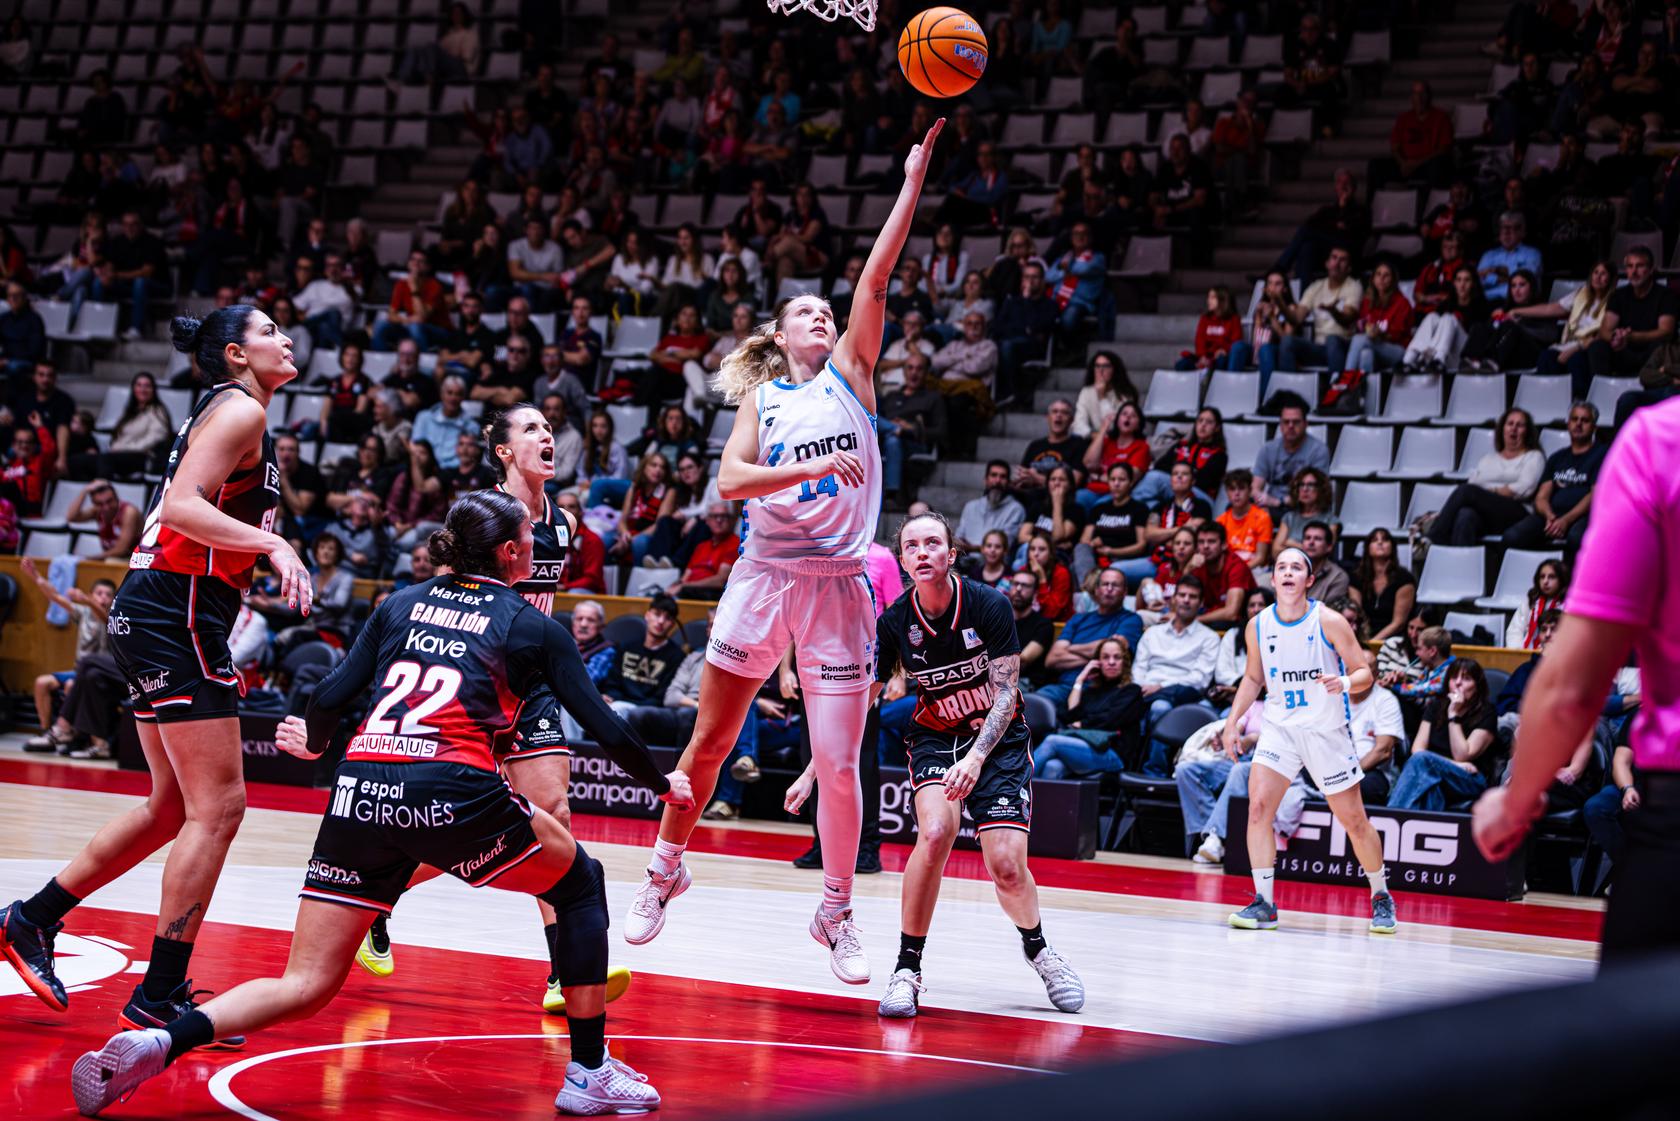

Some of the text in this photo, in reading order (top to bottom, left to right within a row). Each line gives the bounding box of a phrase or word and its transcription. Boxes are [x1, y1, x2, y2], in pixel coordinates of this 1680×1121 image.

[794, 432, 858, 461] mirai
[798, 474, 839, 502] 14
[429, 586, 482, 606] Marlex
[409, 602, 491, 635] CAMILIÓN
[405, 629, 467, 658] Kave
[622, 652, 666, 679] EA7
[821, 663, 860, 672] Donostia
[917, 665, 974, 686] SPAR
[363, 660, 462, 735] 22
[1284, 689, 1309, 709] 31
[360, 780, 404, 799] espai
[567, 781, 660, 811] company
[355, 800, 454, 828] GIRONÈS
[1273, 857, 1457, 886] ISIOMÈDC GRUP
